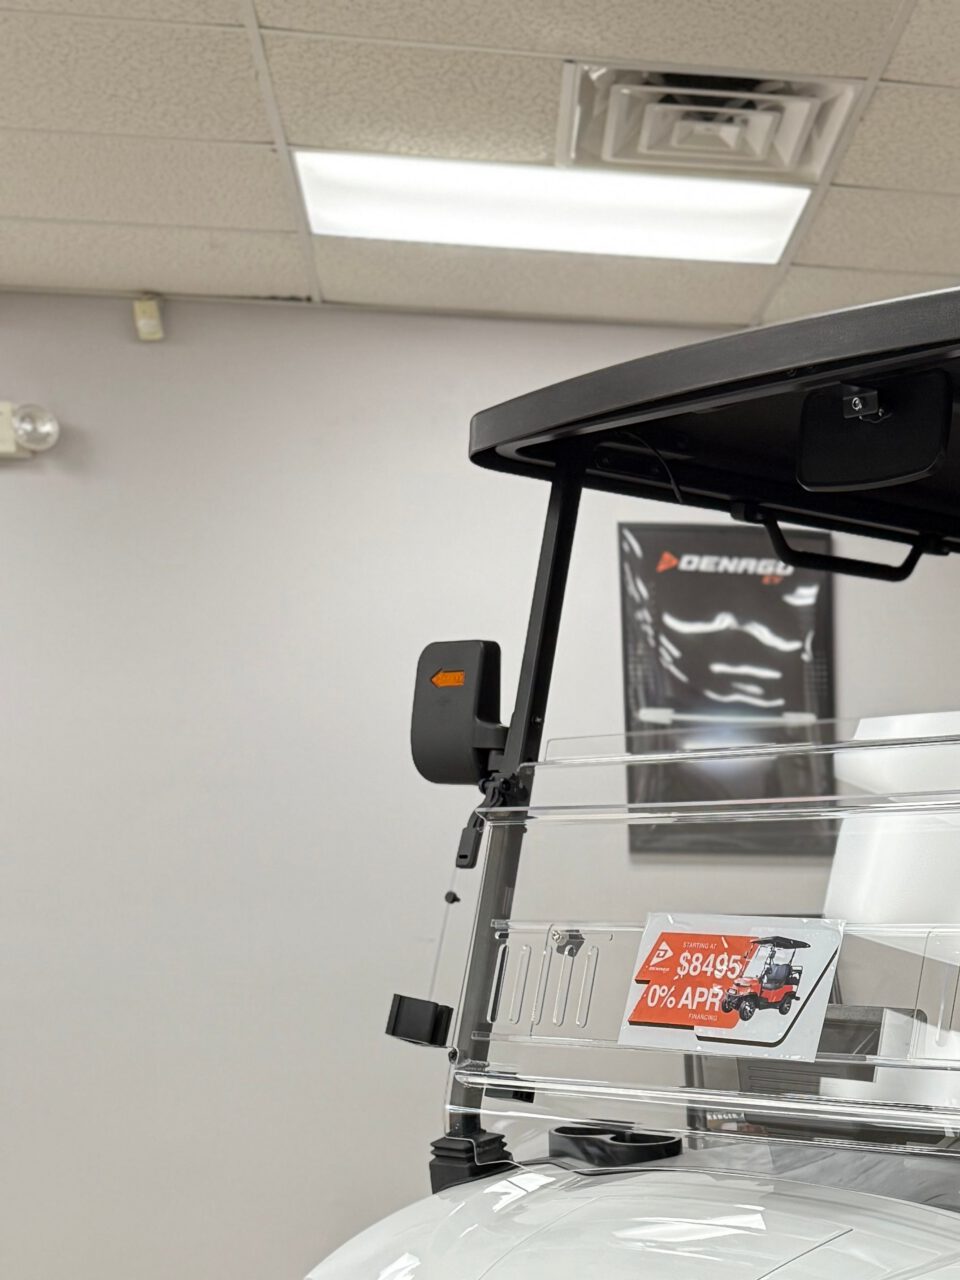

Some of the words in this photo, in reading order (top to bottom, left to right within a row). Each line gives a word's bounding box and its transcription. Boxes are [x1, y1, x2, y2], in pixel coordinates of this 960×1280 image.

[679, 554, 795, 576] DENAGO
[677, 950, 742, 979] $8495
[647, 984, 676, 1008] 0%
[677, 984, 724, 1012] APR
[688, 1013, 718, 1021] FINANCING
